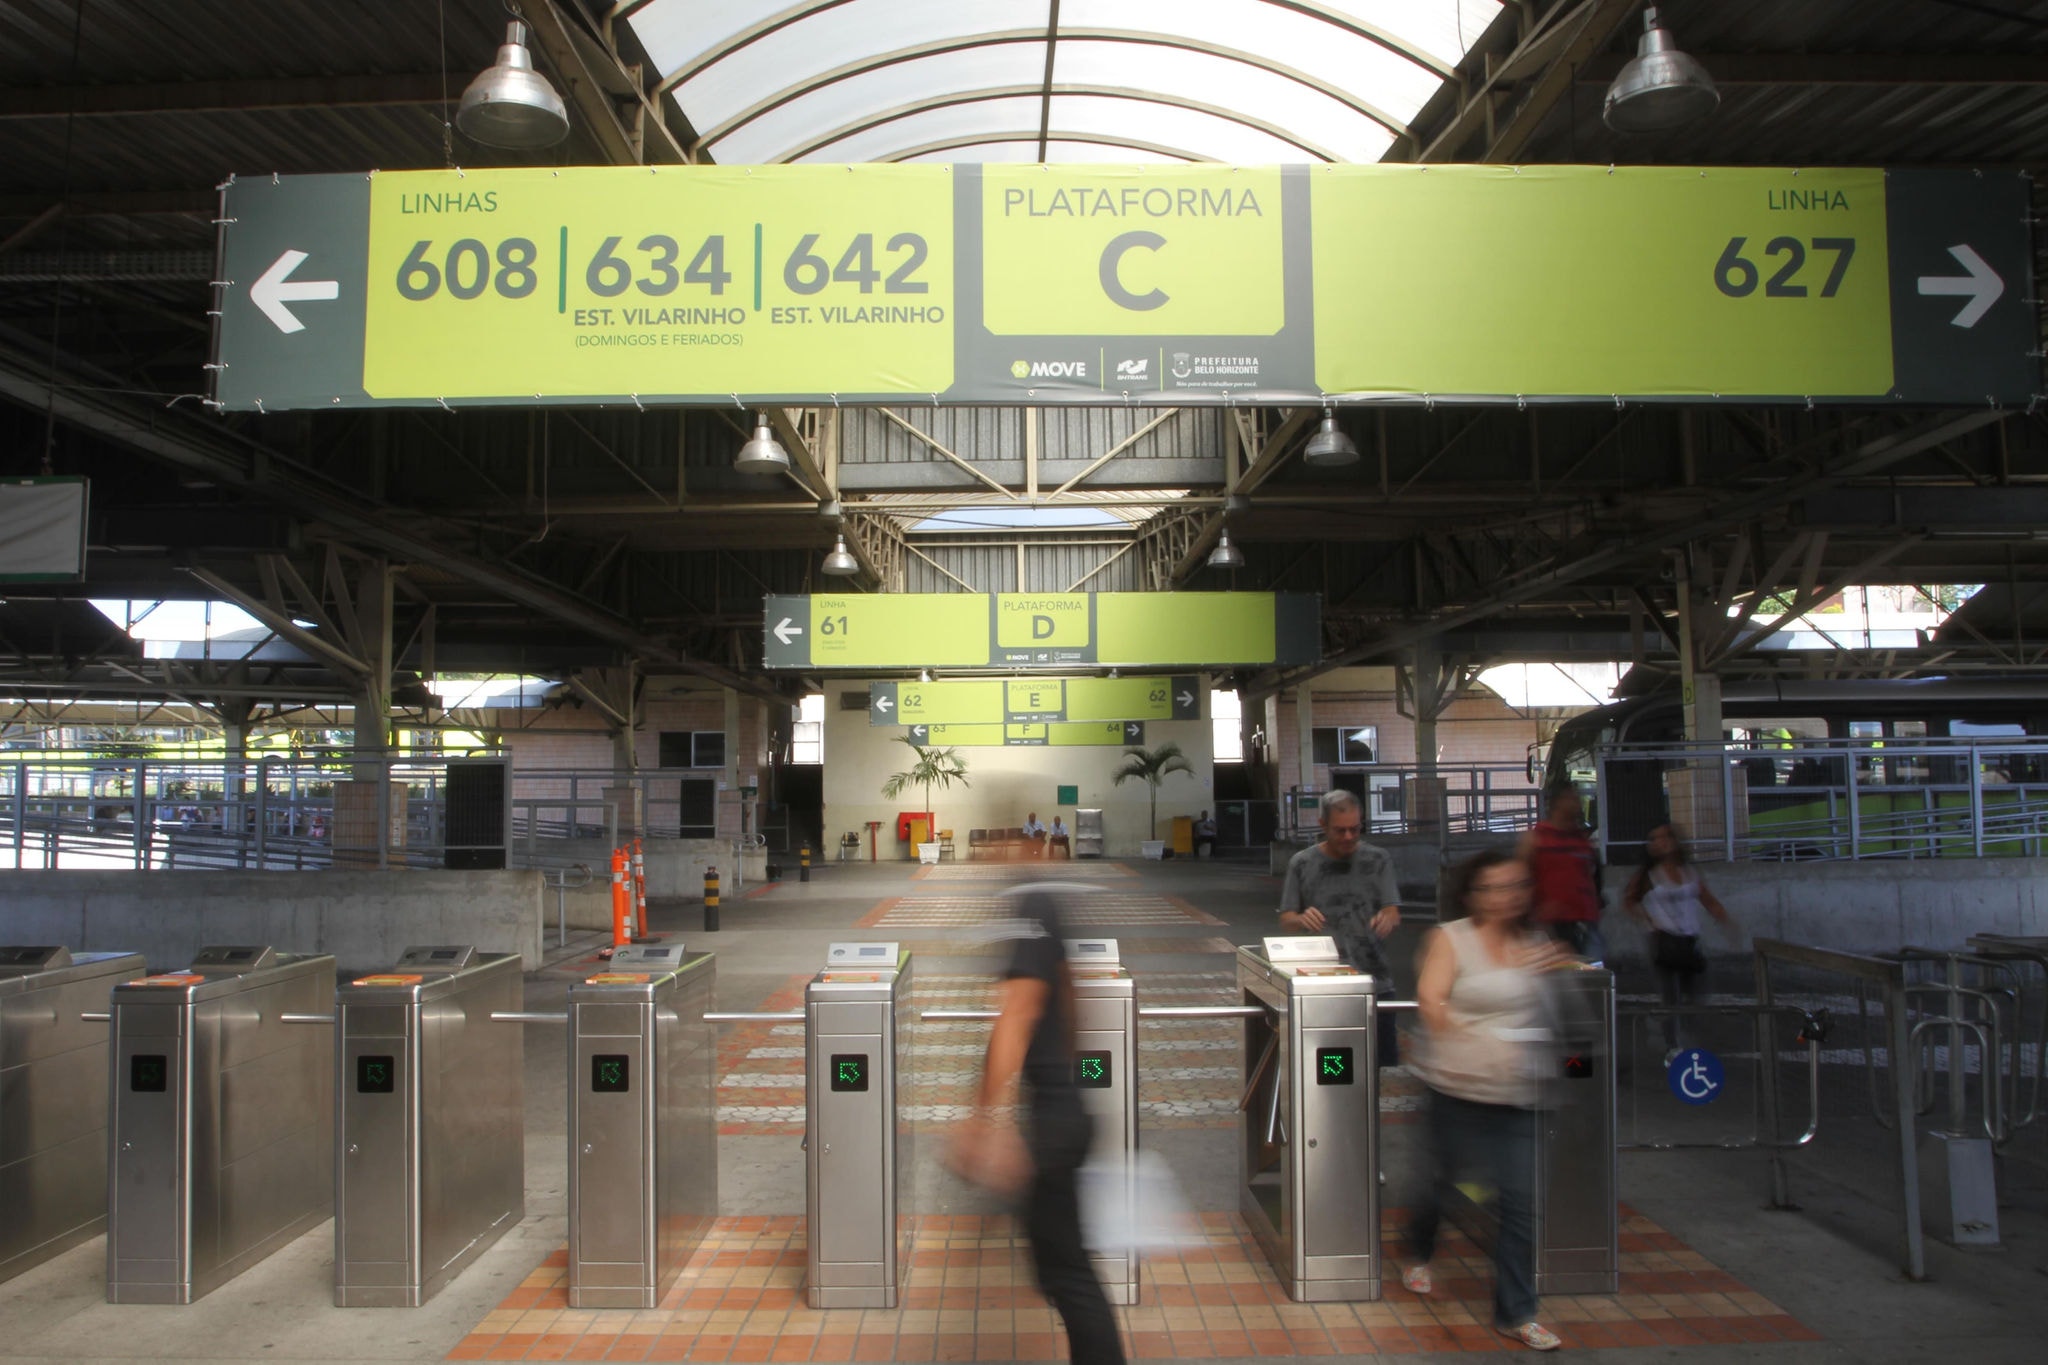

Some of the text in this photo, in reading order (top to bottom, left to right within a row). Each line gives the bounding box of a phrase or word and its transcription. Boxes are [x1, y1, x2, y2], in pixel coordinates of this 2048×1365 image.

[401, 191, 498, 215] LINHAS
[1004, 188, 1263, 217] PLATAFORMA
[1769, 190, 1849, 211] LINHA
[395, 237, 538, 302] 608
[585, 234, 732, 298] 634
[782, 232, 929, 296] 642
[1098, 230, 1171, 312] C
[1713, 236, 1856, 299] 627
[574, 308, 746, 326] EST. VILARINHO
[771, 306, 945, 325] EST. VILARINHO
[575, 333, 744, 349] (DOMINGOS E FERIADOS)
[1030, 361, 1086, 377] MOVE
[1194, 357, 1259, 365] PREFEITURA
[1194, 365, 1259, 374] BELO HORIZONTE
[820, 600, 847, 609] LINHA
[1003, 600, 1083, 612] PLATAFORMA
[820, 615, 848, 636] 61
[1033, 615, 1055, 639] D
[903, 694, 922, 707] 62
[1029, 692, 1041, 708] E
[1149, 689, 1167, 703] 62
[1022, 724, 1031, 736] F
[1106, 723, 1121, 733] 64
